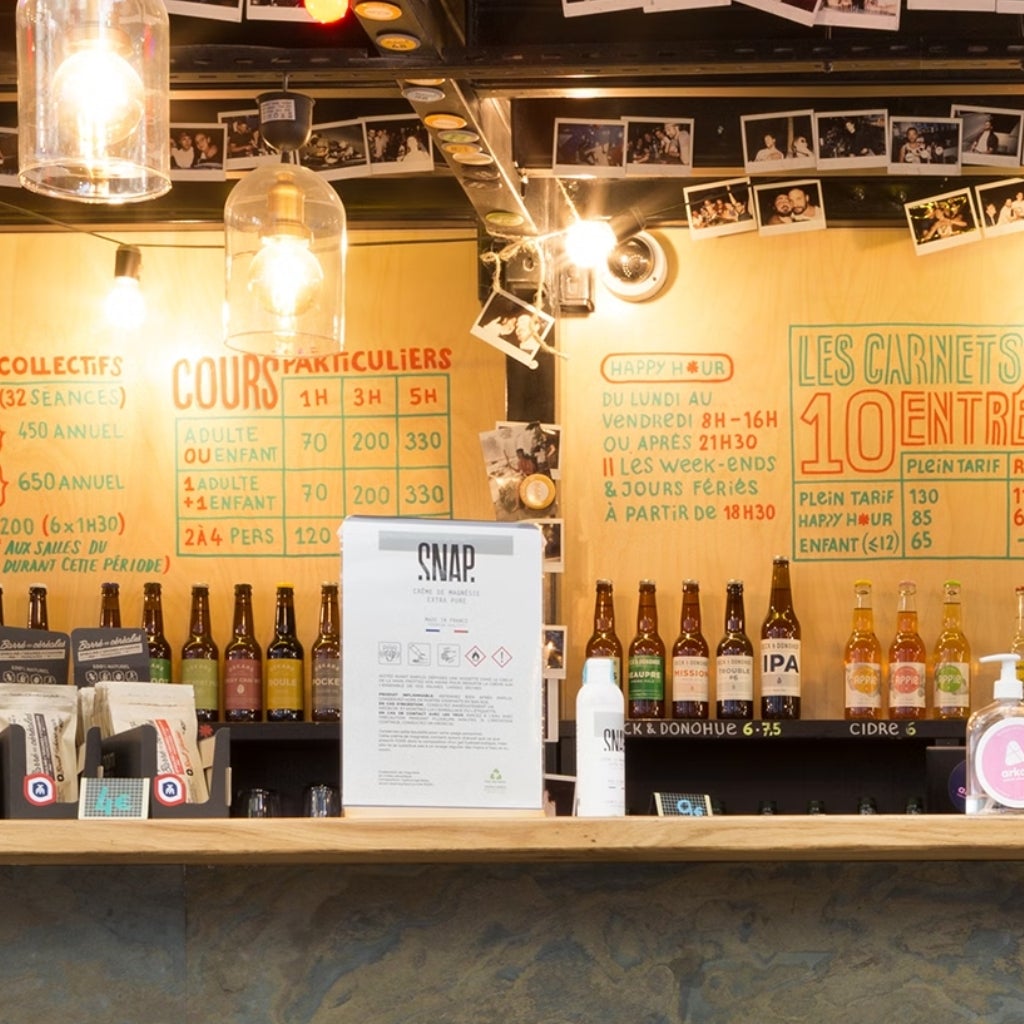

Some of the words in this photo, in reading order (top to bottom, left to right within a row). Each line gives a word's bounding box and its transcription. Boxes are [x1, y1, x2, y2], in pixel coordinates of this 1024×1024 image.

[611, 360, 666, 376] HAPPY
[799, 333, 855, 387] LES
[863, 332, 1024, 386] CARNETS
[172, 356, 278, 410] COURS
[300, 388, 327, 407] 1H
[354, 388, 381, 406] 3H
[409, 387, 437, 405] 5H
[602, 392, 623, 406] DU
[631, 392, 680, 406] LUNDI
[689, 391, 712, 406] AU
[18, 421, 48, 439] 450
[54, 424, 124, 439] ANNUEL
[184, 427, 258, 444] ADULTE
[800, 389, 896, 475] 10
[302, 432, 327, 452] 70
[352, 432, 390, 451] 200
[405, 432, 441, 451] 330
[603, 436, 629, 452] OU
[700, 434, 757, 451] 21H30
[184, 448, 210, 464] OU
[215, 446, 278, 462] ENFANT
[957, 458, 1001, 473] TARIF
[18, 472, 55, 491] 650
[58, 473, 125, 490] ANNUEL
[197, 476, 259, 491] ADULTE
[604, 481, 618, 498] &
[621, 480, 683, 497] JOURS
[302, 483, 328, 502] 70
[353, 485, 390, 505] 200
[405, 484, 444, 504] 330
[909, 488, 939, 505] 130
[210, 495, 277, 511] ENFANT
[605, 501, 618, 523] À
[723, 504, 776, 522] 18H30
[0, 518, 34, 535] 200
[911, 510, 932, 527] 85
[230, 527, 275, 545] PERS
[294, 527, 331, 545] 120
[800, 537, 859, 553] ENFANT
[911, 531, 932, 550] 65
[5, 541, 31, 555] AUX
[34, 541, 81, 555] SALLES
[89, 540, 108, 551] DU
[2, 558, 56, 573] DURANT
[61, 557, 97, 573] CETTE
[763, 655, 799, 673] IPA
[647, 722, 657, 735] &
[906, 722, 917, 736] 6
[95, 784, 131, 816] 4€
